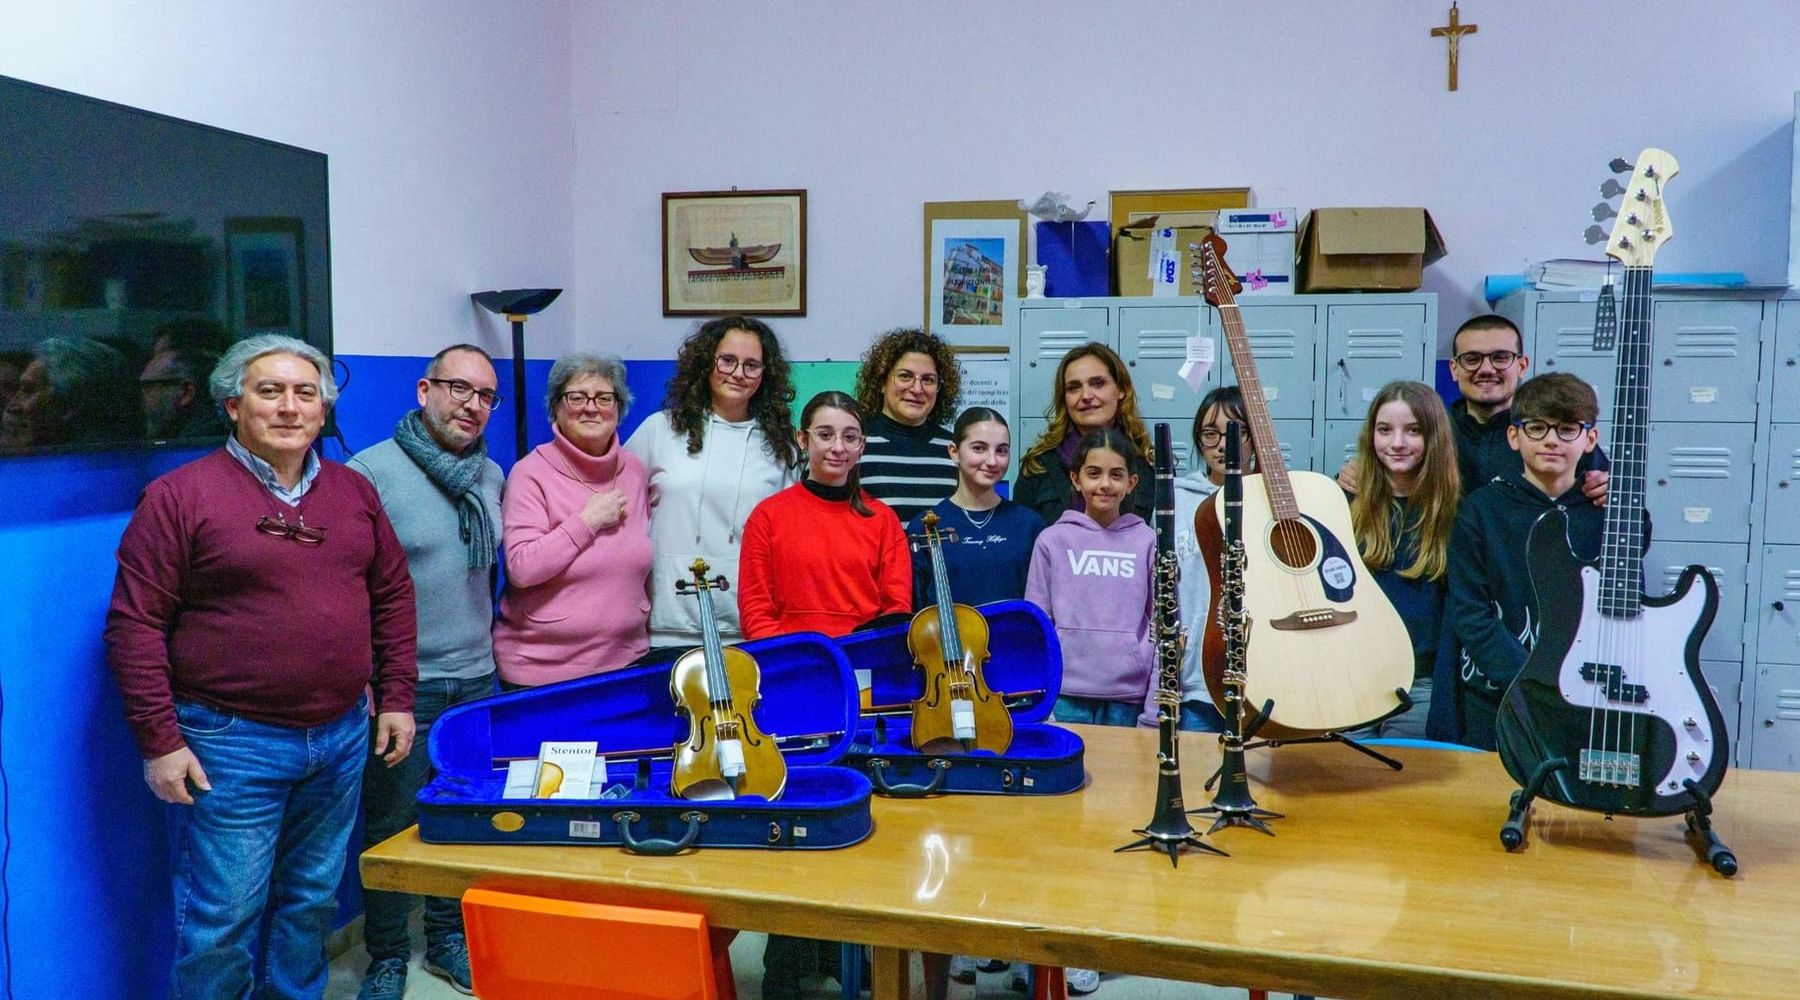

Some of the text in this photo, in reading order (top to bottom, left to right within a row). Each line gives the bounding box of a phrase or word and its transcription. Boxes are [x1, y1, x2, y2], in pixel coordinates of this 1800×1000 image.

[1165, 259, 1176, 284] SDA
[1066, 549, 1137, 579] VANS
[550, 746, 593, 755] Stentor
